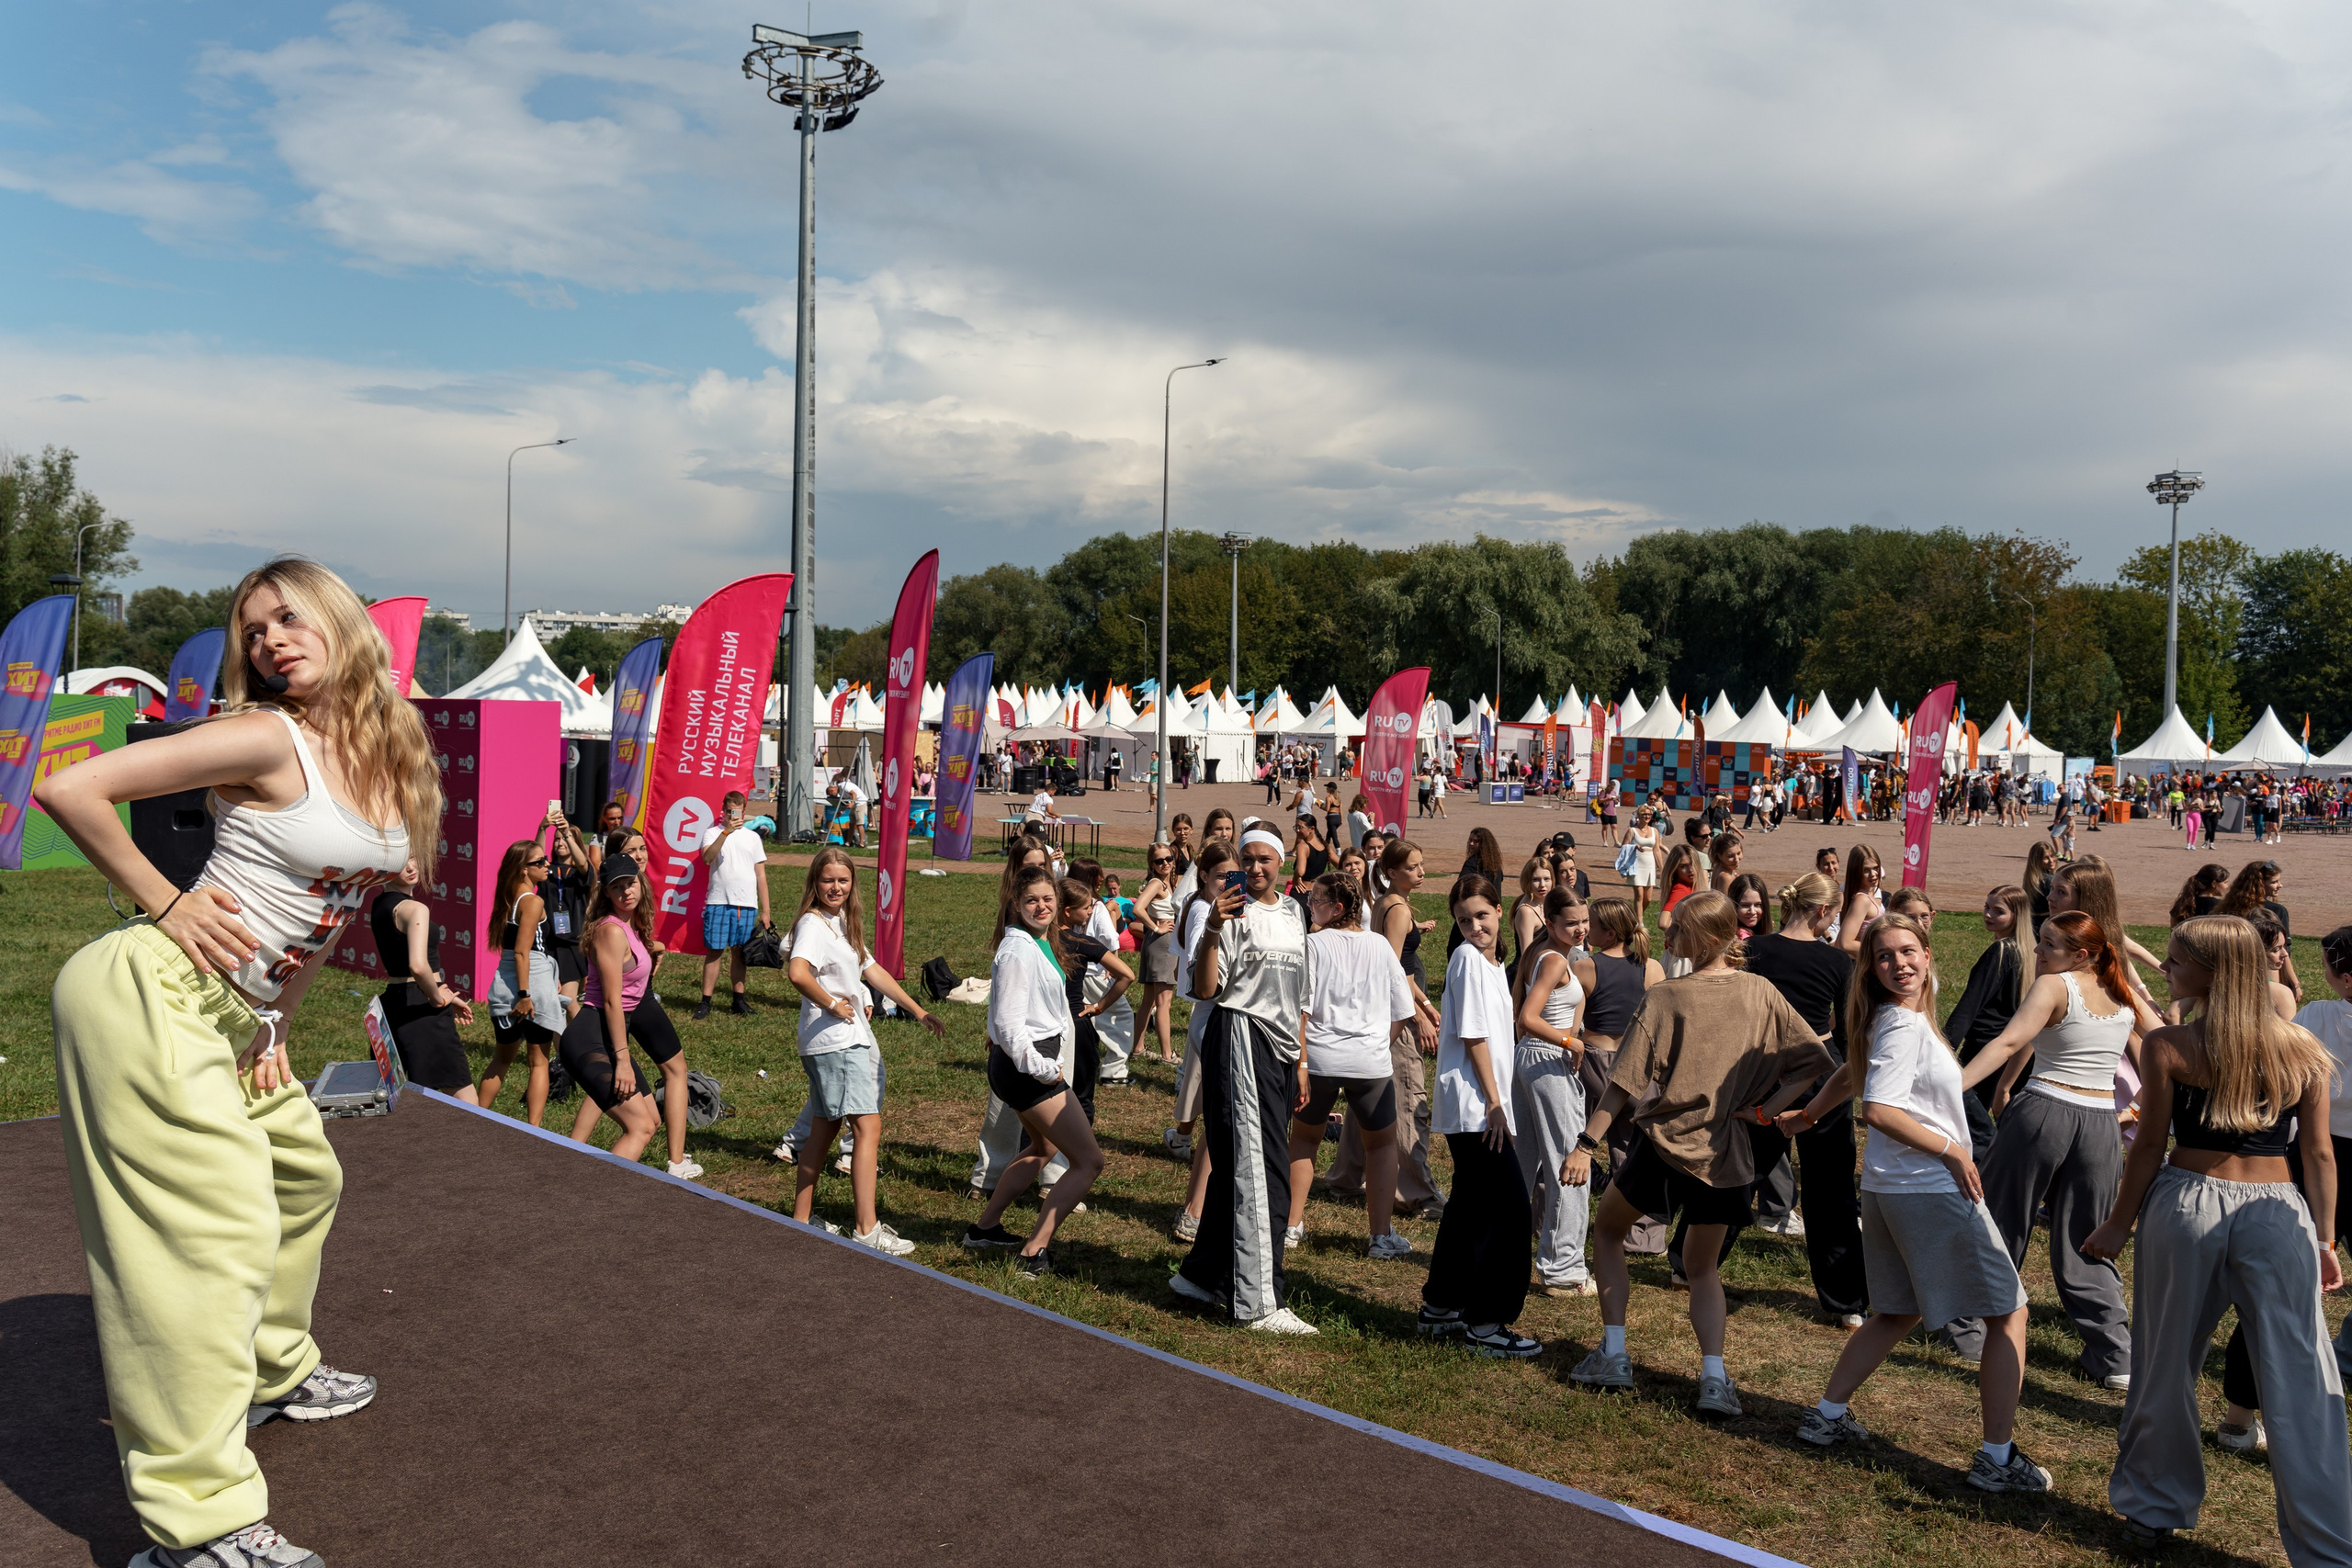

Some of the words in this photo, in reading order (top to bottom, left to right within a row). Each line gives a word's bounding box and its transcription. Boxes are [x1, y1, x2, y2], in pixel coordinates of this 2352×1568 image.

[903, 660, 912, 676] TV
[6, 671, 40, 687] ХИТ
[699, 631, 741, 777] МУЗЫКАЛЬНЫЙ
[63, 722, 82, 735] РАДИО
[721, 667, 757, 779] ТЕЛЕКАНАЛ
[1374, 715, 1394, 728] RU
[678, 689, 707, 774] РУССКИЙ
[1916, 736, 1929, 748] RU
[1369, 770, 1386, 783] RU
[1907, 791, 1920, 804] RU
[677, 807, 700, 842] TV
[1911, 851, 1918, 860] TV
[661, 856, 695, 916] RU
